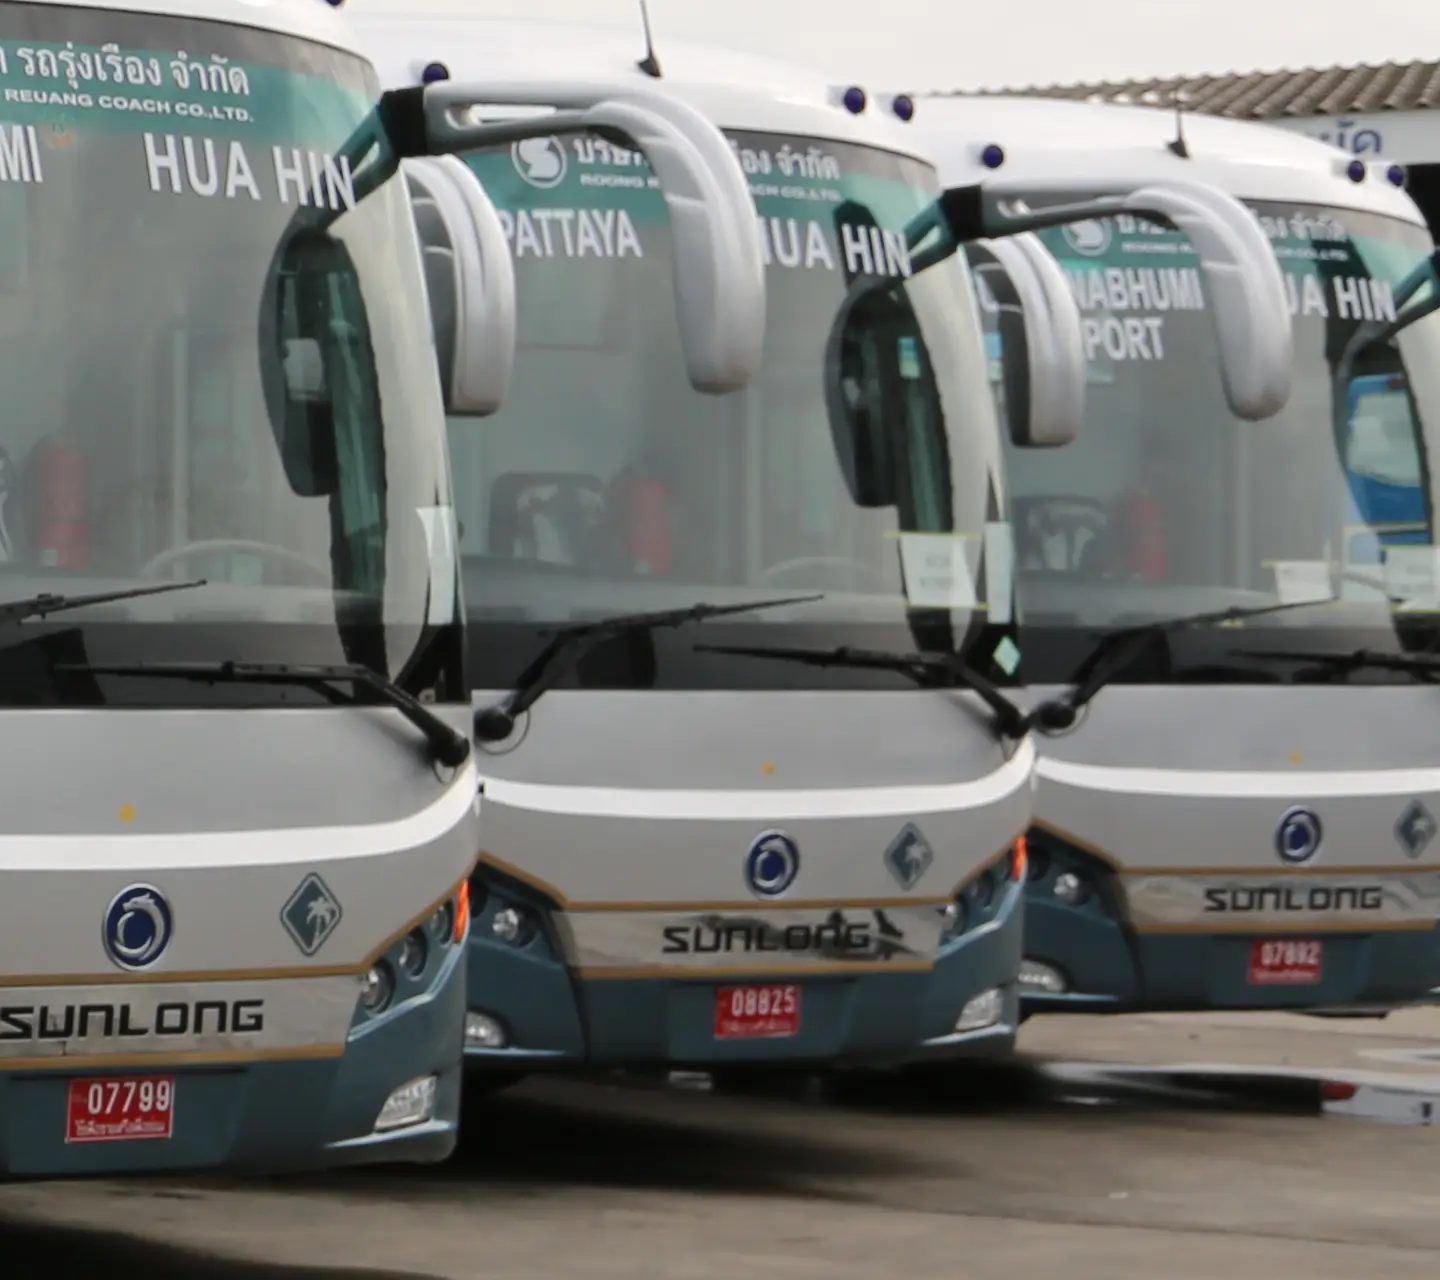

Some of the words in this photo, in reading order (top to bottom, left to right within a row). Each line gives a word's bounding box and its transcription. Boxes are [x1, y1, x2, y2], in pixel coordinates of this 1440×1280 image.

[17, 42, 162, 90] รถรุ่งเรือง
[170, 50, 250, 96] จำกัด
[5, 89, 92, 107] REUANG
[99, 96, 170, 114] COACH
[144, 132, 261, 200] HUA
[272, 146, 356, 211] HIN
[841, 223, 913, 278] HIN
[1332, 275, 1397, 323] HIN
[1083, 317, 1164, 361] PORT
[662, 923, 871, 954] SUNLONG
[88, 1080, 170, 1114] 07799
